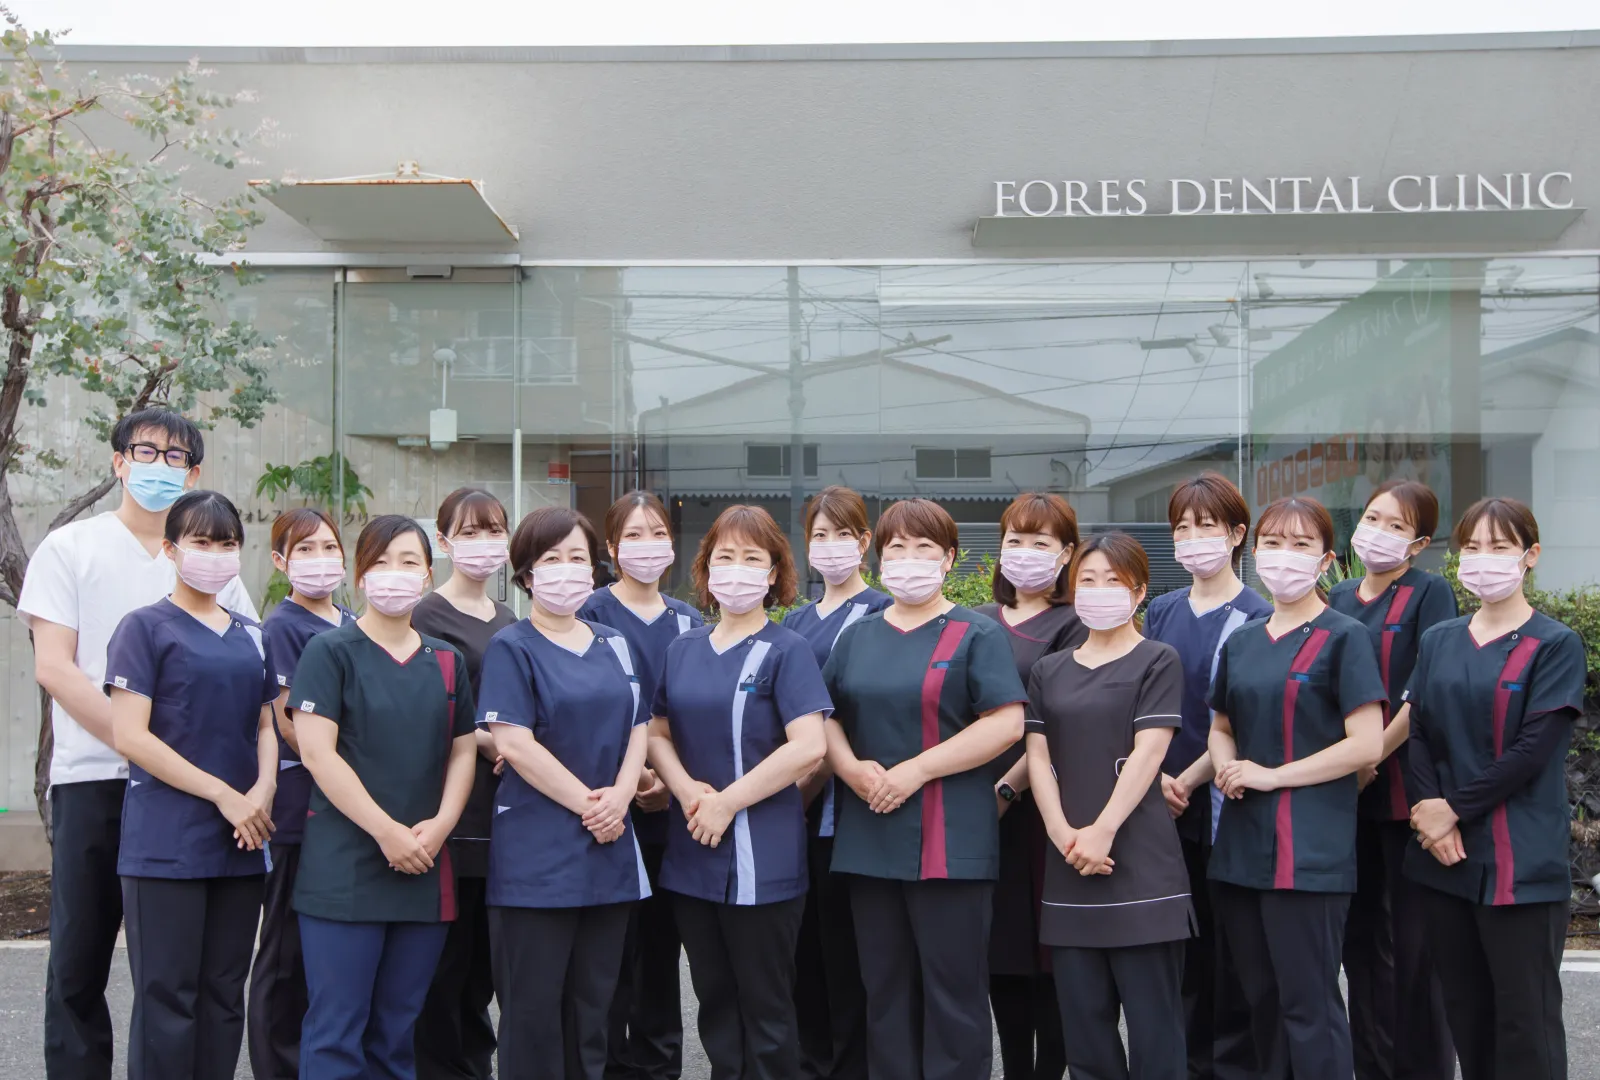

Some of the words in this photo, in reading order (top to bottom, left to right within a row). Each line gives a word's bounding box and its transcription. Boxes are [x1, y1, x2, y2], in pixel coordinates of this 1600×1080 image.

[993, 178, 1148, 217] FORES
[1168, 176, 1374, 216] DENTAL
[1387, 171, 1574, 213] CLINIC
